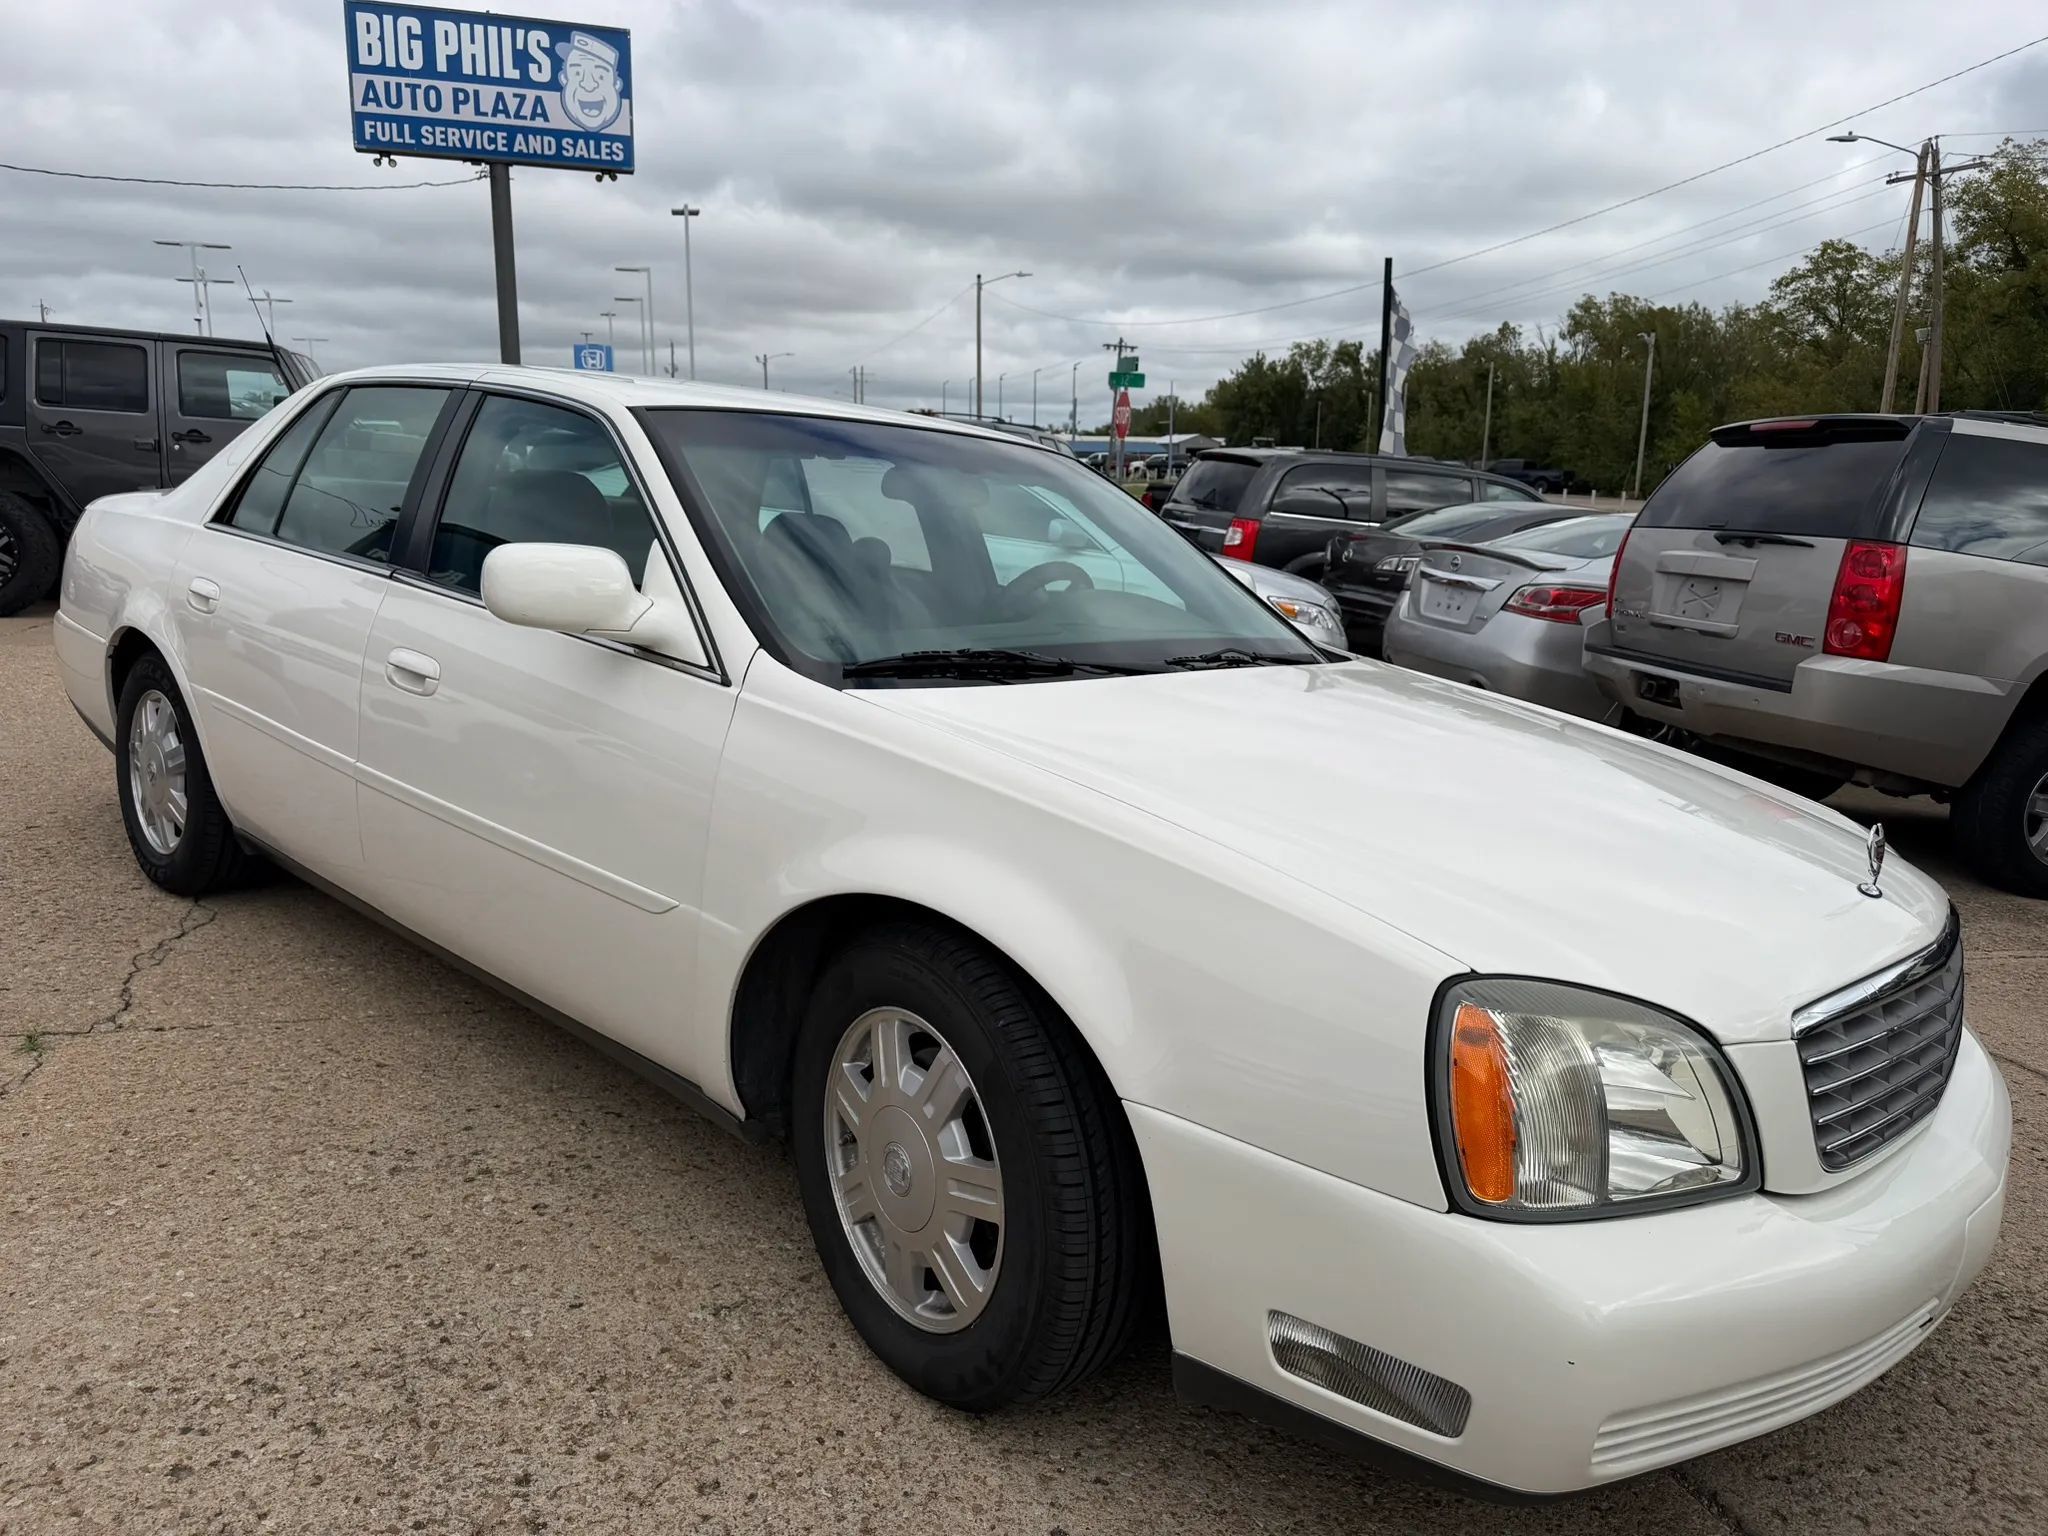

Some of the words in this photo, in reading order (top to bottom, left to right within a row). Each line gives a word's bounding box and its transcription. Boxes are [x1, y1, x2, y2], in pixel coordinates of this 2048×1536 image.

[356, 11, 423, 70] BIG
[434, 19, 552, 83] PHIL'S
[361, 79, 443, 113] AUTO
[452, 87, 550, 123] PLAZA
[364, 120, 416, 144] FULL
[420, 125, 508, 152] SERVICE
[513, 133, 556, 155] AND
[561, 137, 624, 161] SALES
[1115, 406, 1130, 424] STOP
[1775, 631, 1816, 649] GMC
